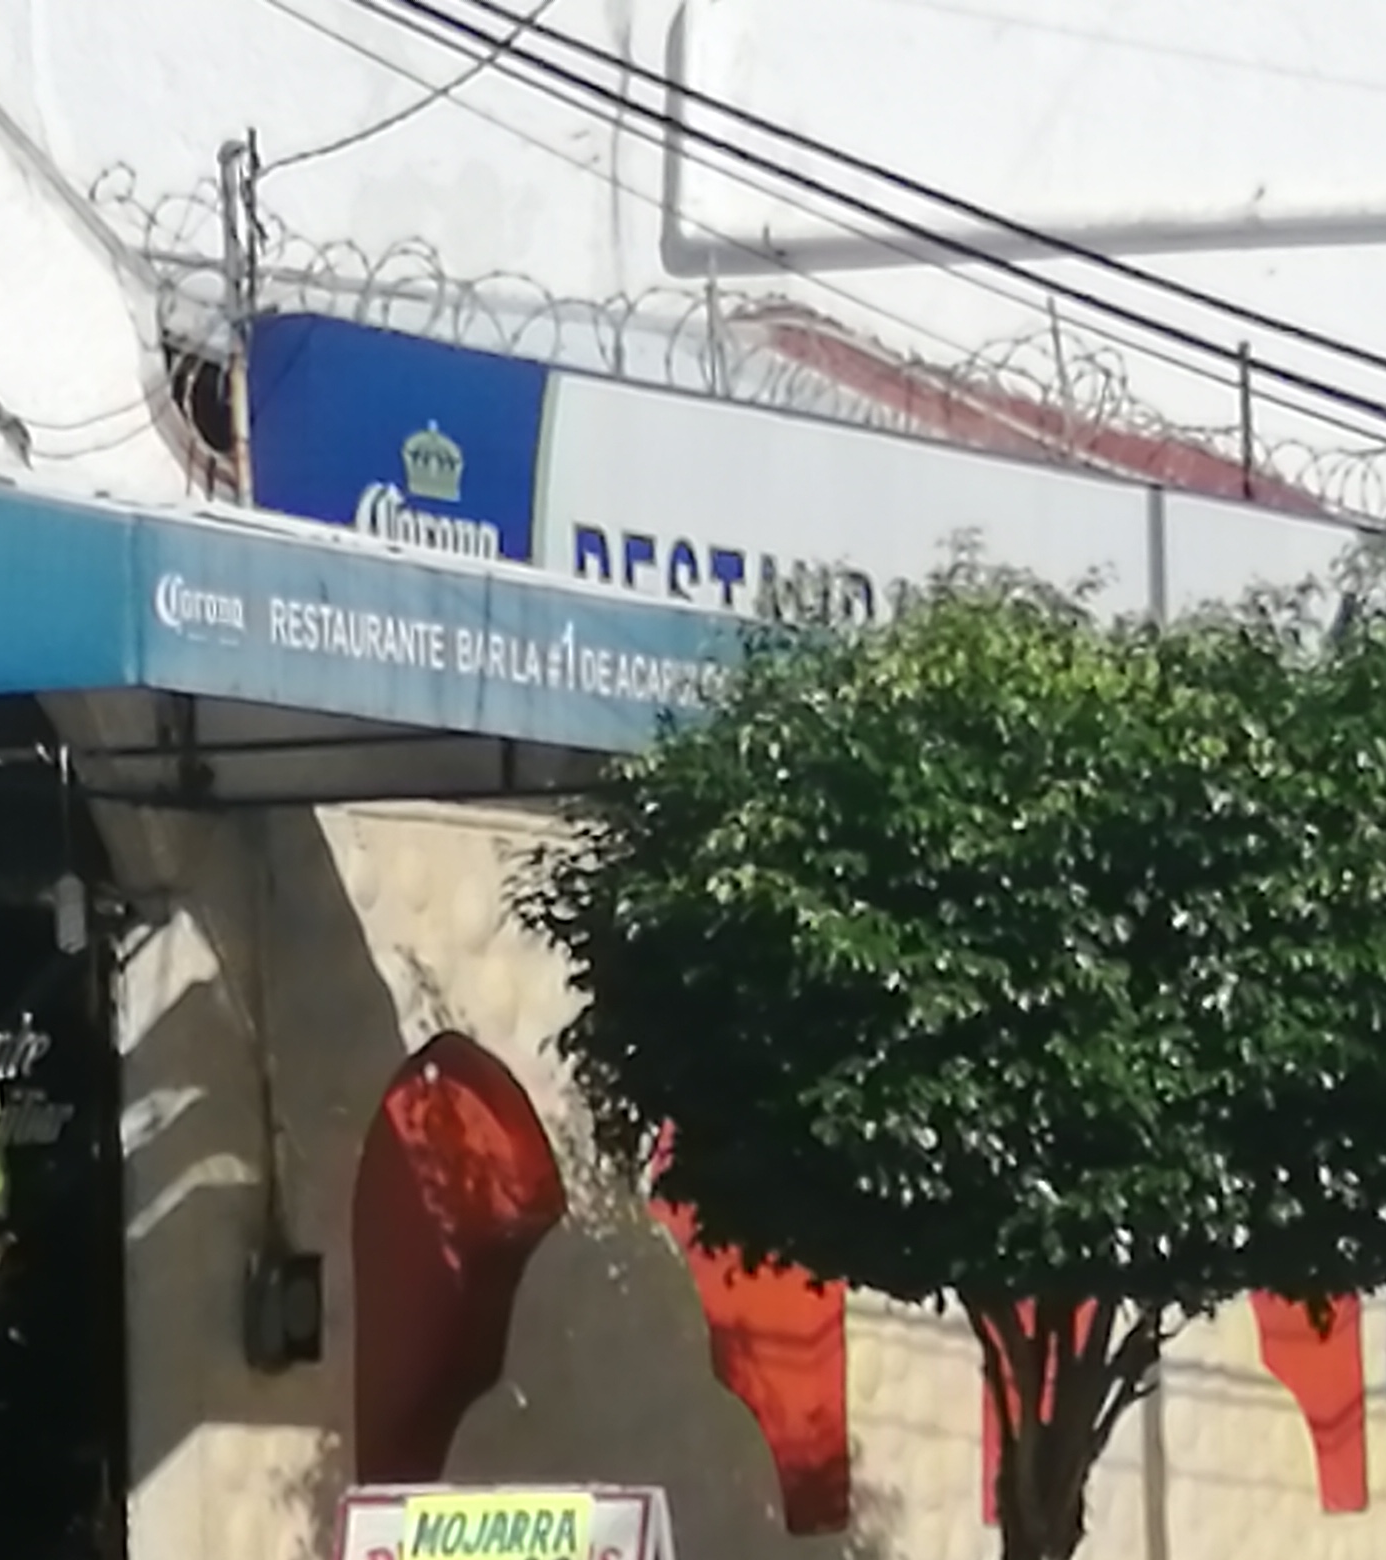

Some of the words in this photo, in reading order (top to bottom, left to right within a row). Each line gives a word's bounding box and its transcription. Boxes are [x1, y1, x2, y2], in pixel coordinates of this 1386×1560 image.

[155, 571, 246, 636] Corona
[269, 595, 446, 672] RESTAURANTE
[456, 626, 506, 680] BAR
[511, 637, 542, 688] LA
[580, 647, 612, 697] DE
[410, 1507, 578, 1558] MOJARRA
